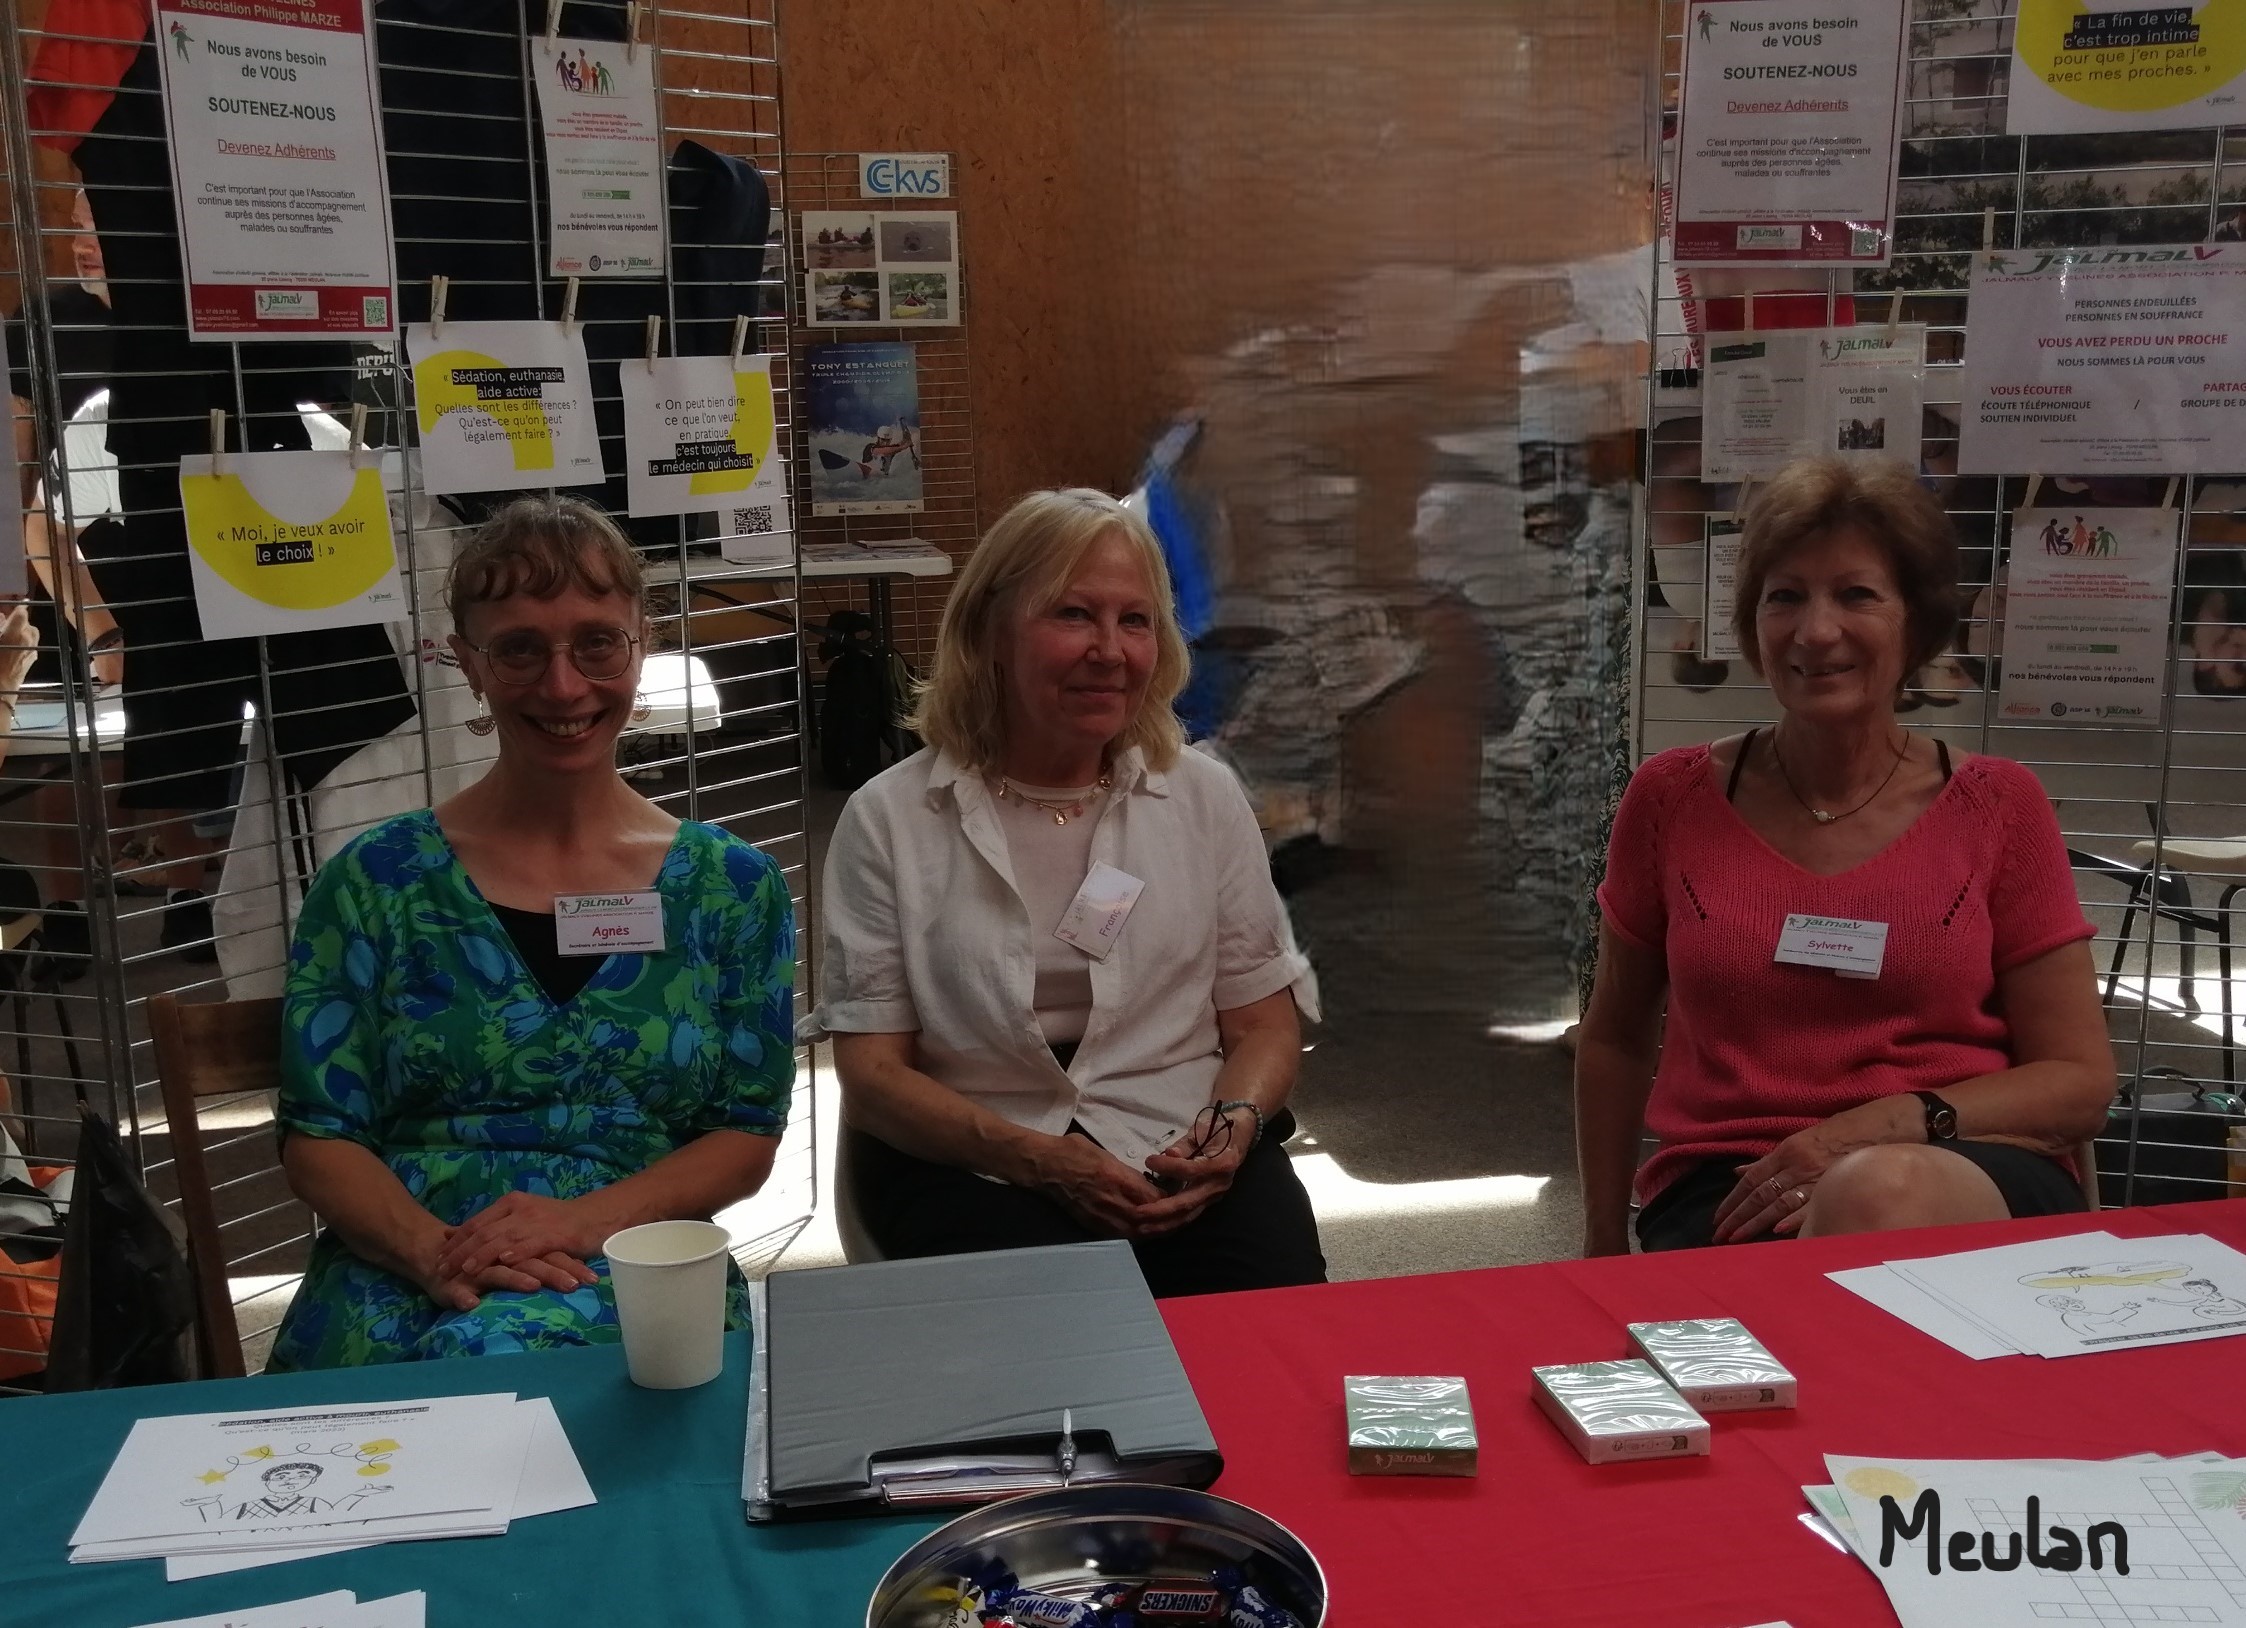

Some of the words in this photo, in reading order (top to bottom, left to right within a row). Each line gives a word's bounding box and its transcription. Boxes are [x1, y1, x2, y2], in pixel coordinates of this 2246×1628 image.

[181, 0, 251, 16] Association
[254, 6, 298, 23] Philippe
[300, 11, 341, 27] MARZE
[2088, 17, 2105, 29] La
[2112, 14, 2132, 27] fin
[2139, 13, 2158, 26] de
[2165, 11, 2192, 24] vie,
[1730, 20, 1763, 32] Nous
[1768, 20, 1808, 31] avons
[1813, 17, 1858, 29] besoin
[1762, 36, 1778, 47] de
[1783, 34, 1822, 46] VOUS
[2064, 35, 2100, 48] c'est
[2107, 33, 2140, 47] trop
[2147, 29, 2198, 42] intime
[208, 40, 241, 57] Nous
[245, 48, 282, 61] avons
[287, 49, 326, 66] besoin
[2054, 55, 2090, 67] pour
[2096, 52, 2125, 66] que
[2130, 49, 2159, 64] j'en
[2166, 45, 2207, 60] parle
[242, 65, 256, 78] de
[261, 67, 297, 82] VOUS
[1723, 64, 1857, 80] SOUTENEZ-NOUS
[2048, 71, 2082, 83] avec
[2088, 70, 2121, 80] mes
[2128, 65, 2197, 81] proches.
[209, 97, 336, 121] SOUTENEZ-NOUS
[1727, 101, 1781, 113] Devenez
[1785, 100, 1849, 112] Adhérents
[218, 139, 271, 156] Devenez
[274, 143, 336, 159] Adhérents
[1707, 138, 1727, 146] C'est
[1730, 138, 1768, 148] important
[1771, 138, 1789, 148] pour
[1791, 138, 1807, 147] que
[1809, 137, 1861, 146] l'Association
[1696, 148, 1731, 157] continue
[1751, 148, 1787, 157] missions
[1721, 157, 1749, 168] auprès
[1752, 158, 1767, 166] des
[1769, 159, 1812, 168] personnes
[1734, 169, 1769, 177] malades
[1785, 168, 1831, 176] souffrantes
[206, 183, 226, 193] C'est
[229, 185, 267, 196] important
[269, 188, 286, 197] pour
[290, 190, 304, 199] que
[307, 189, 355, 199] l'Association
[198, 197, 232, 205] continue
[252, 199, 286, 208] missions
[289, 201, 366, 212] d'accompagnement
[225, 211, 252, 220] auprès
[255, 211, 270, 220] des
[273, 213, 314, 222] personnes
[241, 224, 275, 233] malades
[290, 226, 333, 234] souffrantes
[572, 223, 606, 231] bénévoles
[625, 223, 658, 232] répondent
[2075, 298, 2131, 309] PERSONNES
[2134, 295, 2196, 307] ENDEUILLÉES
[2066, 312, 2122, 322] PERSONNES
[2125, 312, 2137, 321] EN
[2140, 310, 2203, 320] SOUFFRANCE
[2039, 338, 2072, 348] VOUS
[2075, 337, 2106, 347] AVEZ
[2110, 336, 2151, 346] PERDU
[2155, 335, 2174, 346] UN
[2178, 334, 2228, 345] PROCHE
[811, 362, 842, 370] TONY
[846, 361, 909, 369] ESTANGUET
[2058, 358, 2085, 367] NOUS
[2087, 357, 2130, 366] SOMMES
[2133, 355, 2144, 365] LÀ
[2147, 356, 2175, 365] POUR
[2178, 355, 2205, 365] VOUS
[452, 371, 506, 384] Sédation,
[478, 386, 501, 398] aide
[506, 386, 542, 397] active:
[1860, 386, 1875, 394] êtes
[1990, 386, 2020, 395] VOUS
[2023, 384, 2072, 395] ÉCOUTER
[435, 403, 473, 416] Quelles
[476, 402, 500, 412] sont
[504, 400, 519, 411] les
[522, 400, 571, 411] différences
[665, 399, 681, 411] On
[686, 399, 705, 412] peut
[707, 397, 724, 408] bien
[727, 396, 745, 407] dire
[1981, 400, 2017, 410] ÉCOUTE
[2020, 399, 2091, 410] TÉLÉPHONIQUE
[2181, 399, 2220, 408] GROUPE
[2224, 399, 2236, 407] DE
[459, 417, 509, 430] Qu'est-ce
[514, 415, 540, 427] qu'on
[543, 415, 562, 425] peut
[665, 415, 677, 426] ce
[683, 414, 699, 427] que
[702, 413, 716, 423] l'on
[718, 412, 740, 423] veut,
[1981, 414, 2020, 423] SOUTIEN
[2023, 413, 2077, 423] INDIVIDUEL
[464, 431, 522, 444] légalement
[525, 428, 545, 439] faire
[679, 430, 691, 441] en
[695, 428, 732, 443] pratique,
[676, 444, 699, 456] c'est
[701, 442, 736, 457] toujours
[649, 463, 658, 474] le
[662, 460, 705, 473] médecin
[708, 458, 721, 472] qui
[723, 455, 753, 470] choisit
[232, 525, 268, 542] Moi,
[273, 523, 286, 543] je
[291, 523, 323, 537] veux
[329, 519, 365, 534] avoir
[257, 547, 271, 562] le
[277, 544, 314, 560] choix
[2028, 672, 2076, 681] bénévoles
[2104, 676, 2154, 684] répondent
[593, 926, 629, 939] Agnès
[1808, 940, 1853, 952] Sylvette
[1140, 1592, 1212, 1613] SNICKERS
